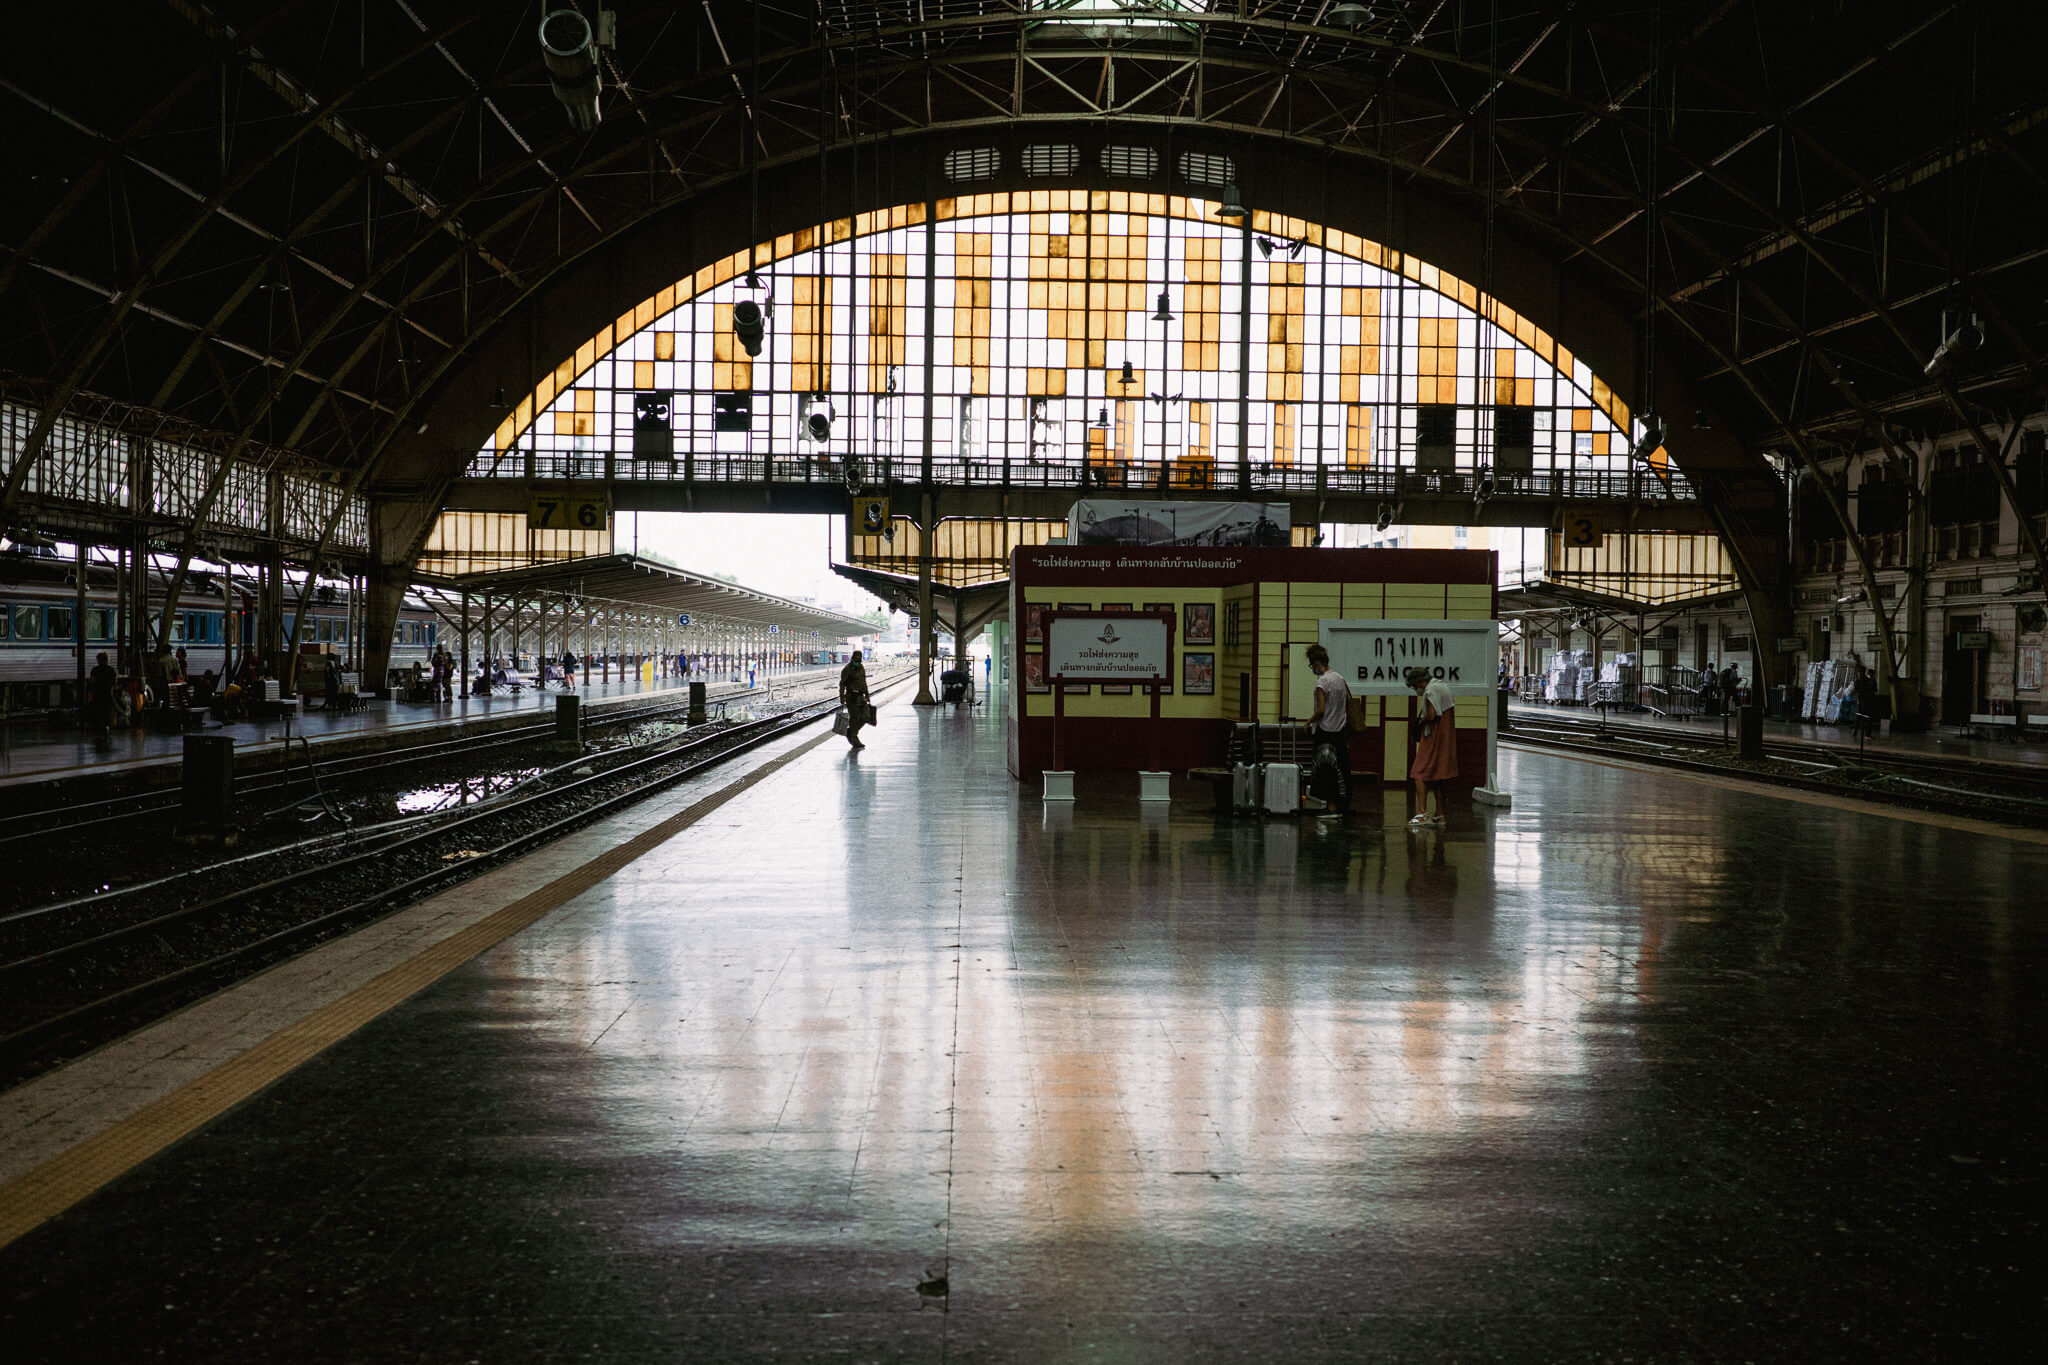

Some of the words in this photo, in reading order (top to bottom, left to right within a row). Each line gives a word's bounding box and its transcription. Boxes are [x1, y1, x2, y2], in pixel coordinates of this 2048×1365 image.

[538, 502, 558, 527] 7
[578, 503, 597, 527] 6
[1574, 519, 1594, 545] 3
[679, 614, 690, 625] 6
[770, 625, 777, 633] 6
[910, 617, 920, 628] 5
[1374, 637, 1444, 665] กรุงเทพ
[1357, 666, 1461, 681] BANOK
